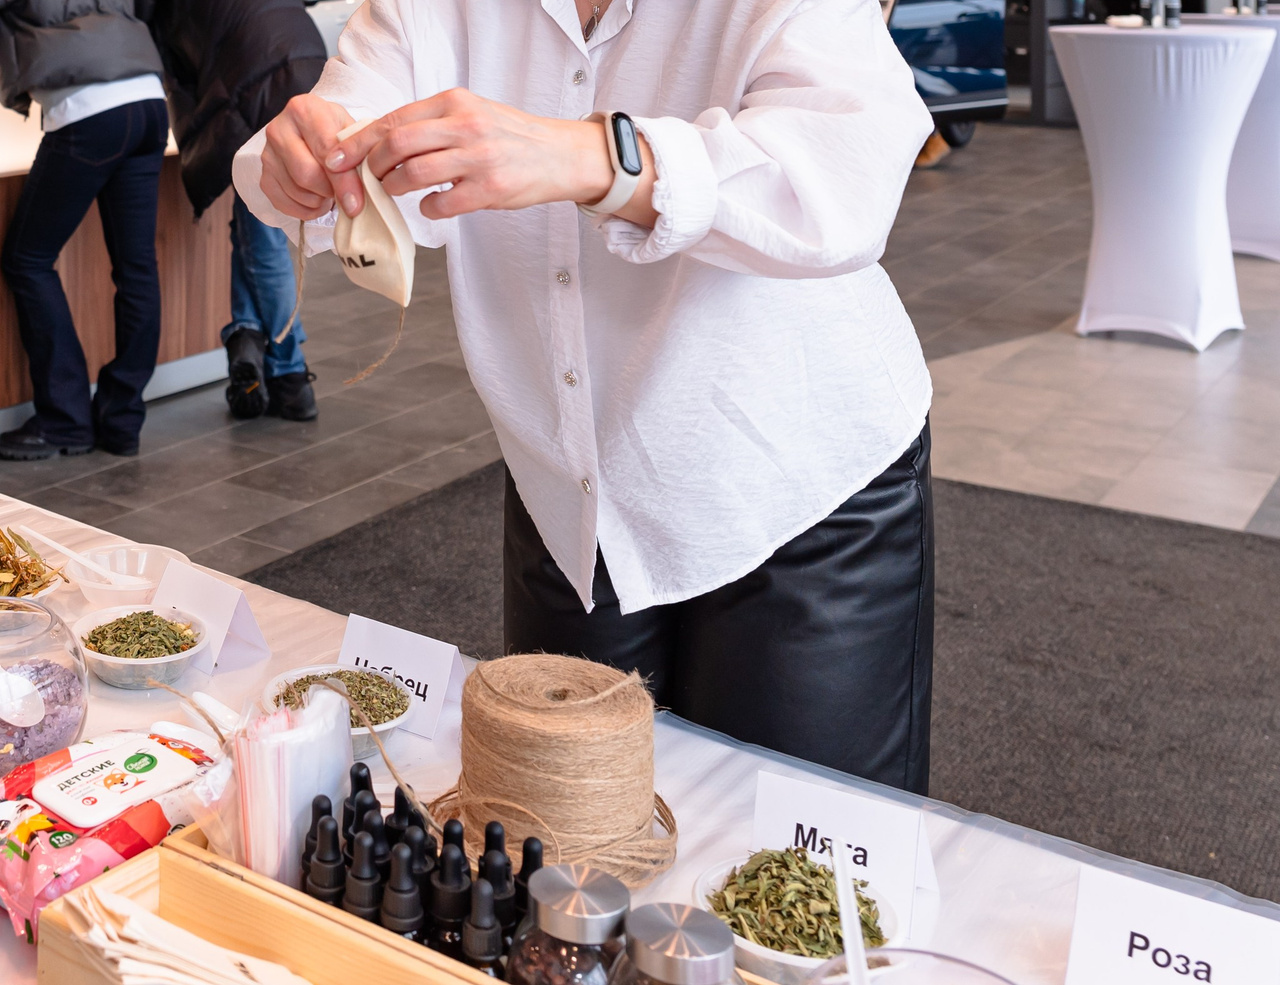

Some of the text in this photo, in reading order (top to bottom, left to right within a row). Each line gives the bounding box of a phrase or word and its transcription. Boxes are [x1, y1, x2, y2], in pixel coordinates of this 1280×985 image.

[57, 759, 115, 792] ДЕТСКИЕ
[51, 832, 73, 844] 120
[794, 822, 868, 868] Мяа
[1127, 930, 1212, 984] Роза
